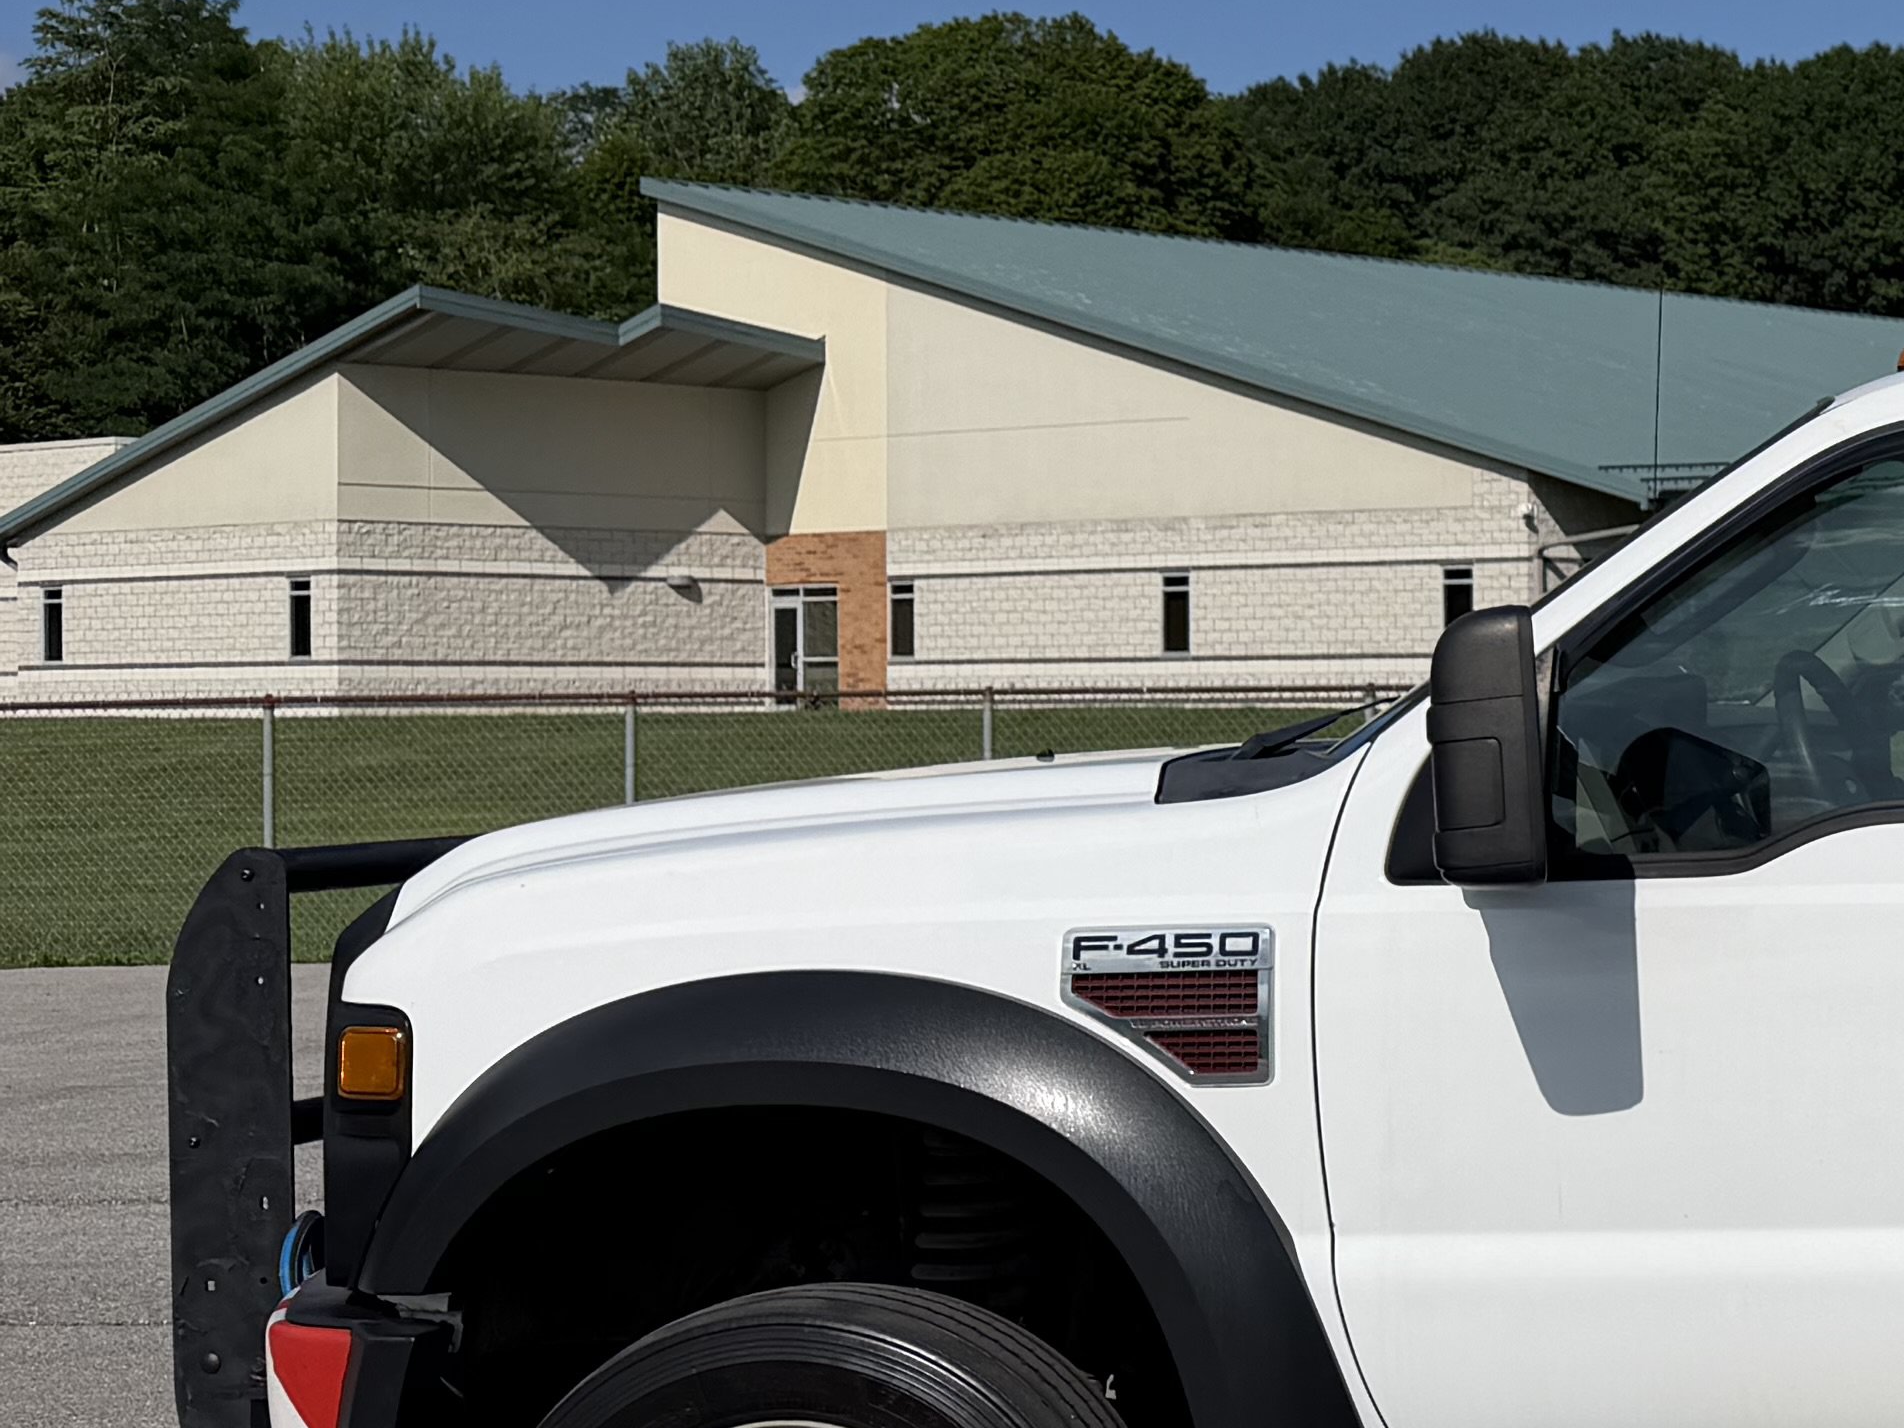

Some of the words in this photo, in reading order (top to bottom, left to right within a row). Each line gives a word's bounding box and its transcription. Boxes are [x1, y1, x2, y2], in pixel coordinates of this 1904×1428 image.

[1072, 931, 1260, 961] F-450
[1159, 959, 1211, 969] SUPER
[1215, 958, 1259, 968] DUTY
